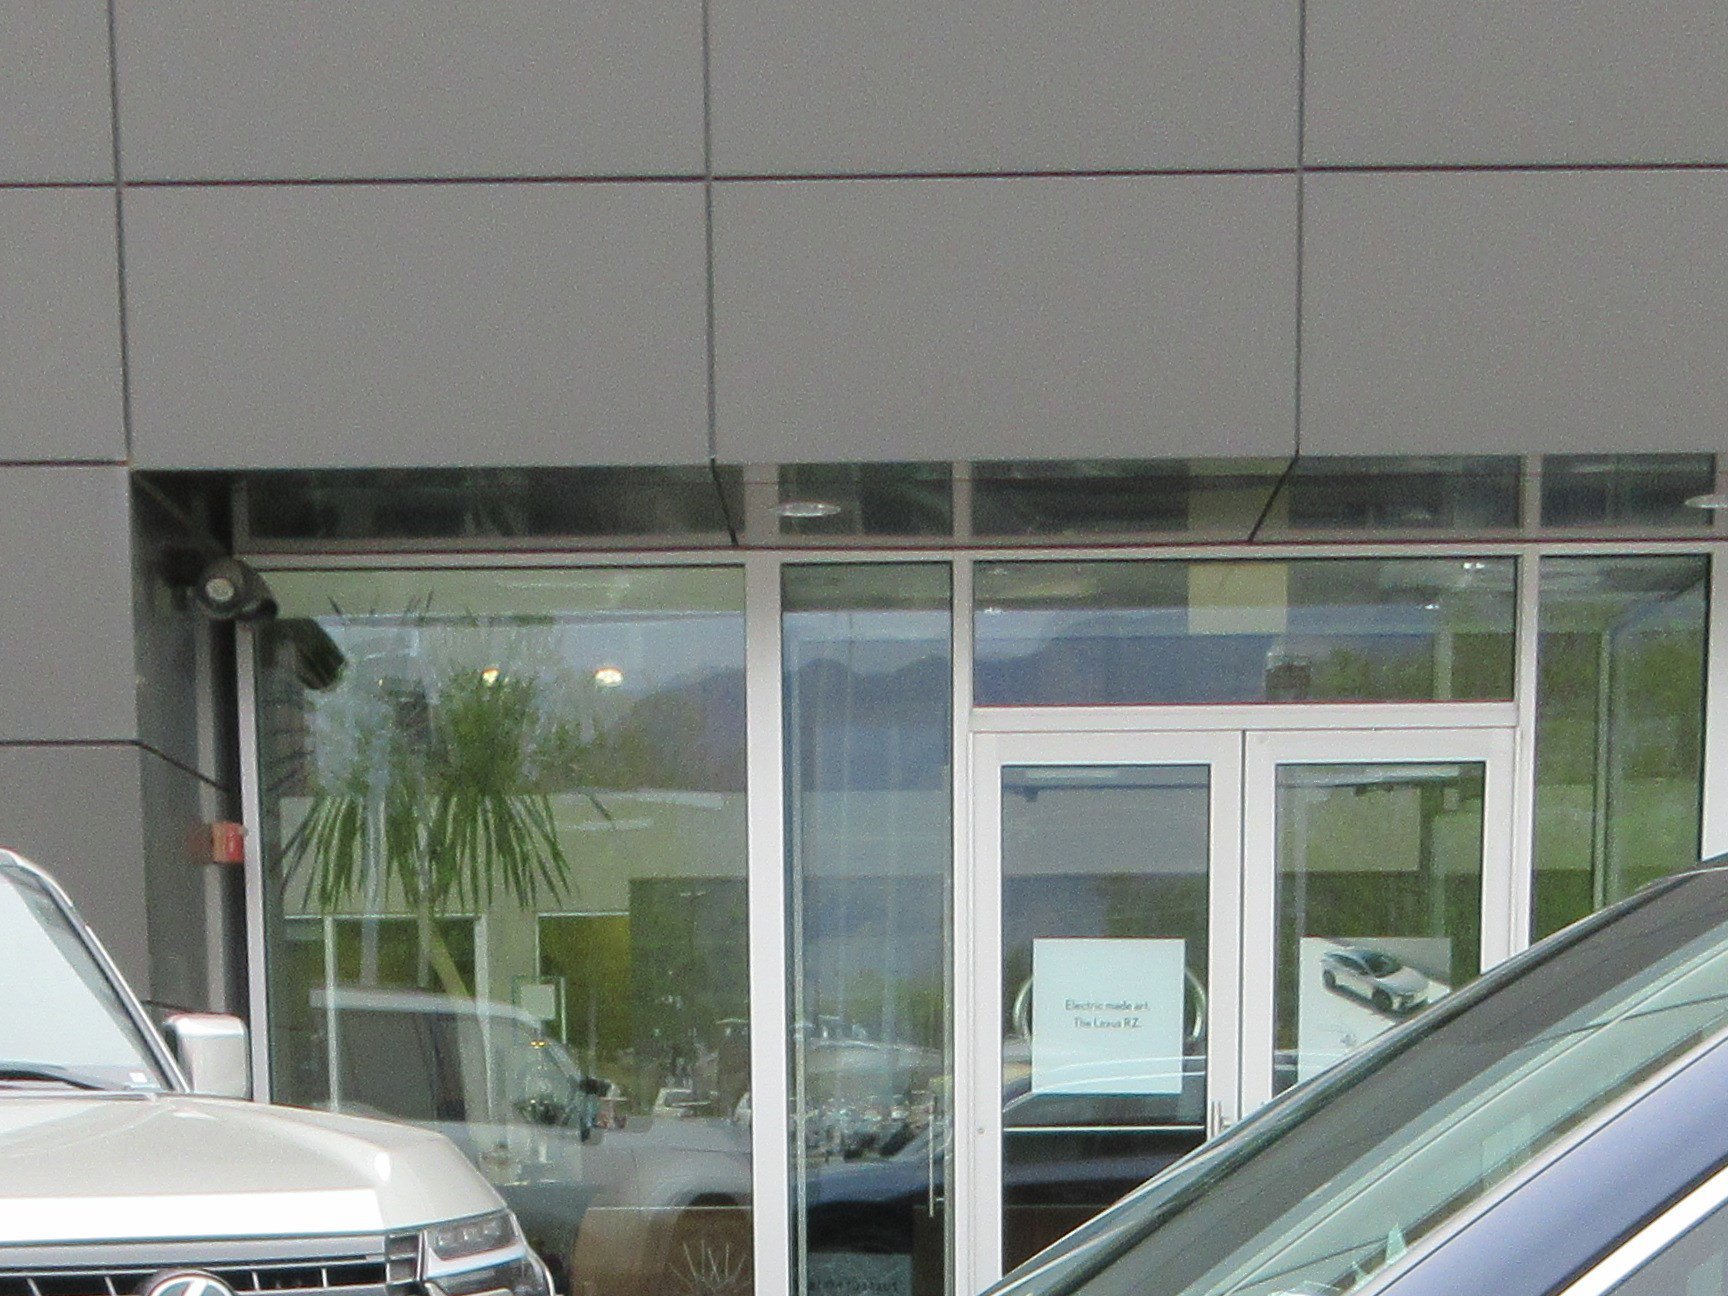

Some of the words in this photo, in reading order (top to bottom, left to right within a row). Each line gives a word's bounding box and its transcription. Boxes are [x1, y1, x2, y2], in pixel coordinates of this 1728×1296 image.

[1065, 999, 1104, 1010] Electric
[1106, 999, 1132, 1010] made
[1074, 1017, 1091, 1027] The
